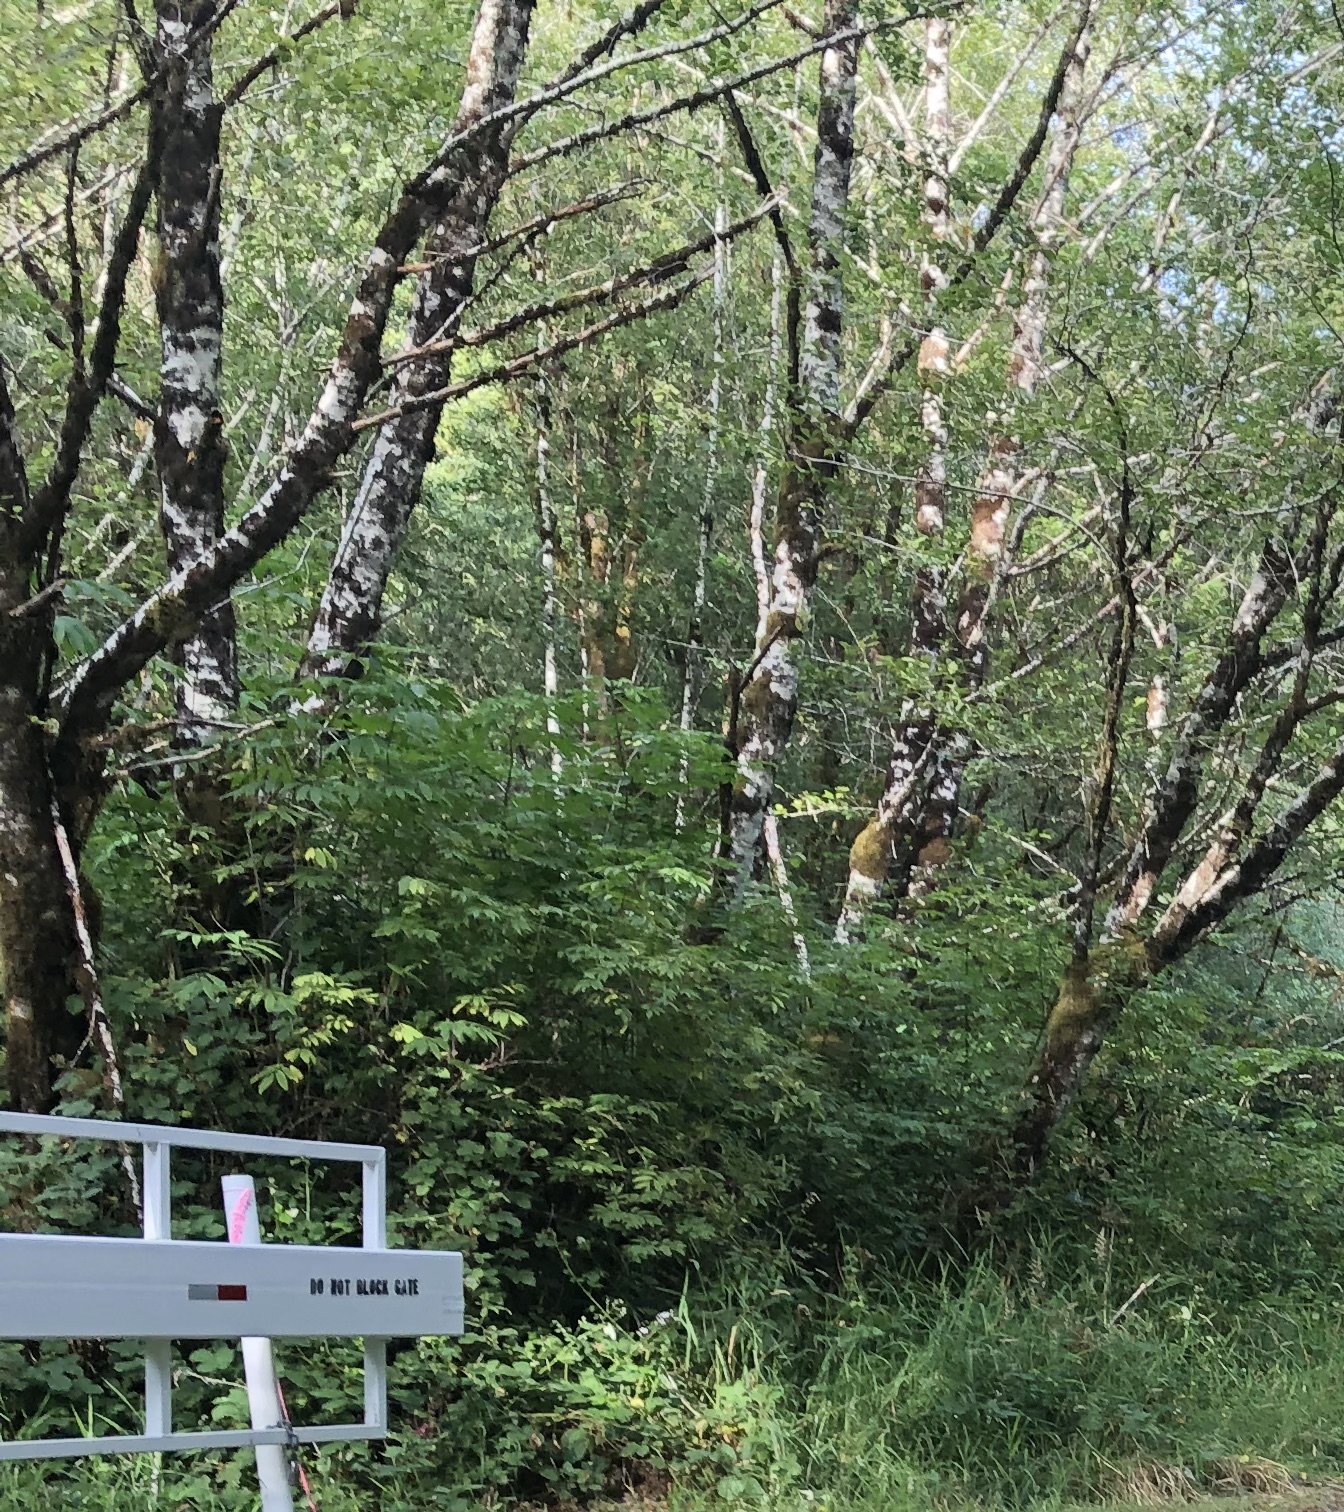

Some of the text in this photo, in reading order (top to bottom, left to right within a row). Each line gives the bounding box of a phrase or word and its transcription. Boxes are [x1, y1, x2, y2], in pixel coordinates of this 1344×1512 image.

[310, 1278, 419, 1297] DO NOT BLOCK GATE
